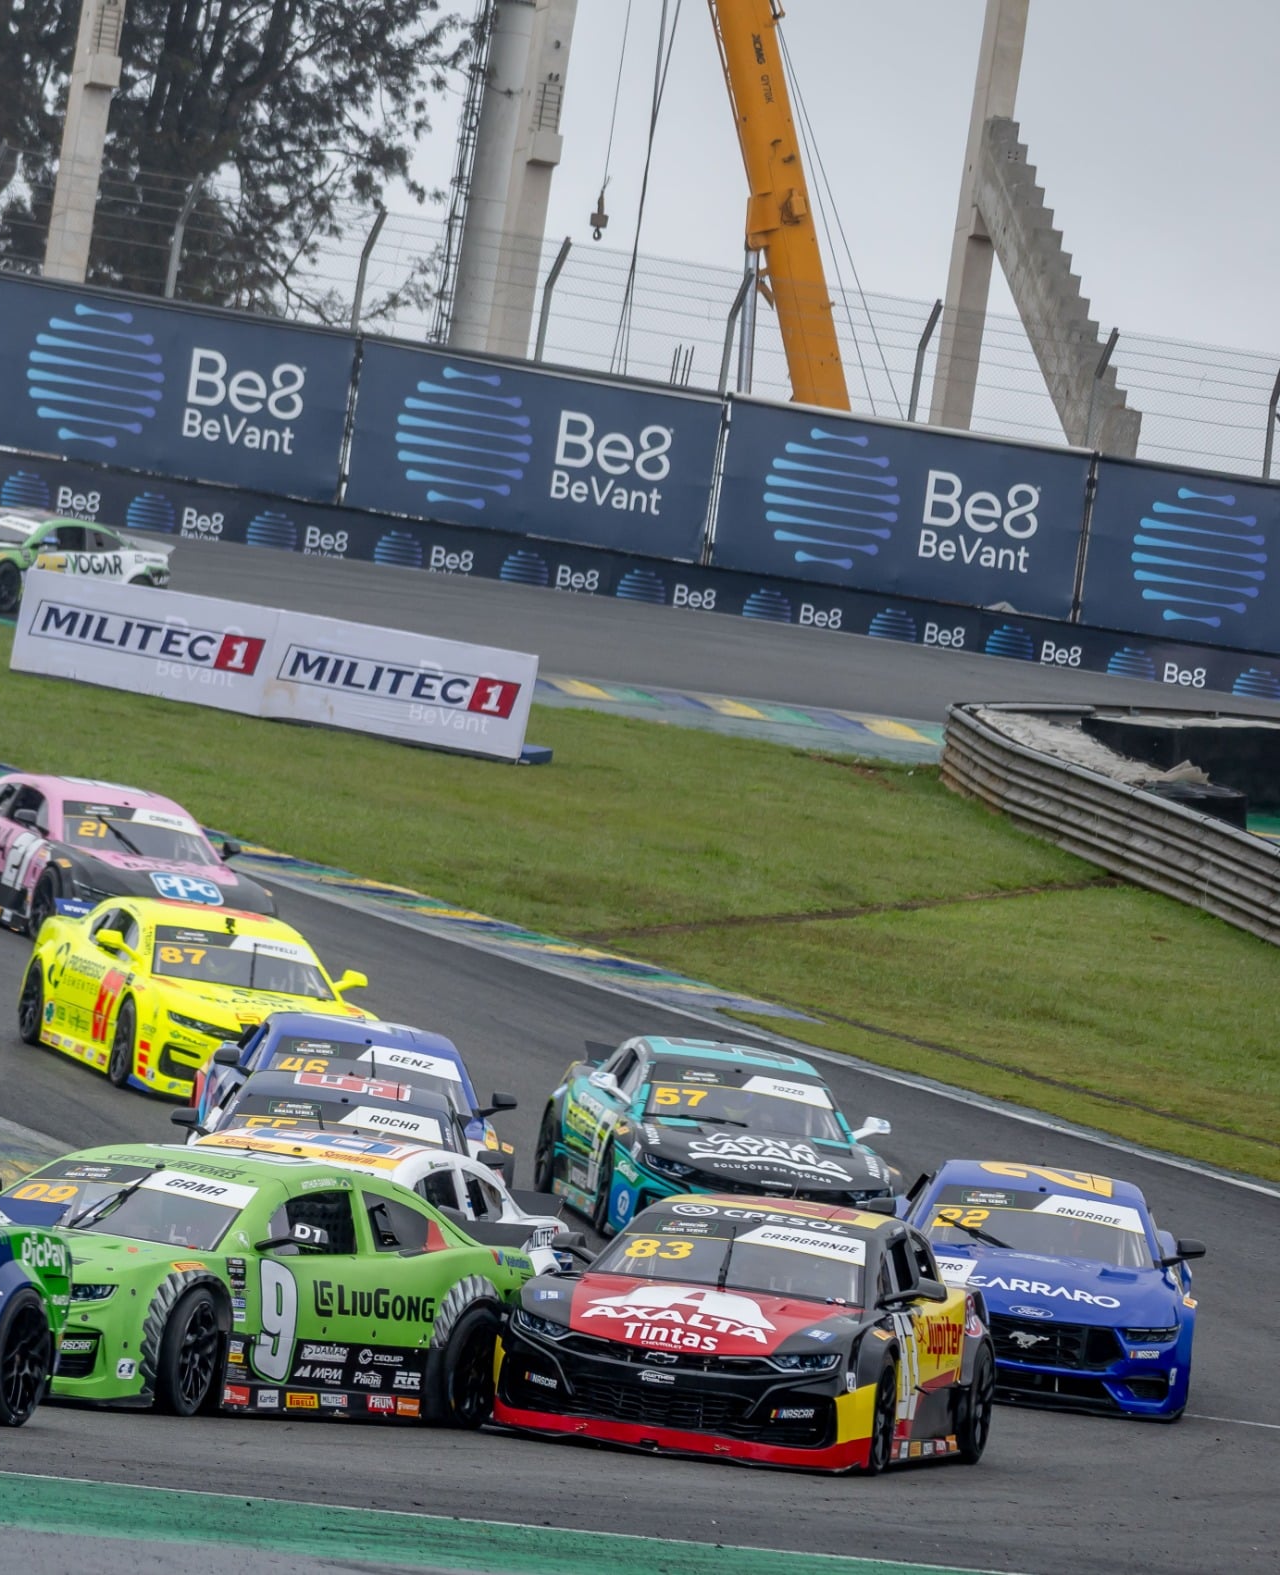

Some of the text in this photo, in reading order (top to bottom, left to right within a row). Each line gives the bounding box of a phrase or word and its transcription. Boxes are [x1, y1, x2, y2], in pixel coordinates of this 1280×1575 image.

[186, 347, 305, 421] Be8
[181, 408, 295, 455] BeVant
[554, 409, 672, 481] Be8
[57, 486, 101, 514] Be8
[549, 470, 662, 516] BeVant
[922, 469, 1040, 539] Be8
[182, 508, 224, 535] Be8
[305, 526, 348, 554] Be8
[918, 529, 1029, 573] BeVant
[68, 554, 123, 576] VOGAR
[430, 545, 474, 572] Be8
[556, 565, 599, 592] Be8
[673, 584, 716, 610] Be8
[799, 604, 842, 630] Be8
[41, 606, 250, 669] MILITEC 1
[923, 623, 965, 648] Be8
[1040, 640, 1082, 667] Be8
[288, 651, 504, 713] MILITEC 1
[1163, 662, 1206, 688] Be8
[78, 821, 108, 838] 21
[160, 874, 217, 898] PPG
[159, 946, 206, 964] 87
[278, 1057, 330, 1073] 46
[389, 1054, 435, 1070] GENZ
[655, 1087, 708, 1107] 57
[772, 1085, 805, 1096] TOZZO
[368, 1114, 421, 1131] ROCHA
[707, 1132, 819, 1158] CANA
[688, 1141, 849, 1174] CAYANA
[713, 1161, 832, 1184] SOLUÇÕES EM AÇÚCAR
[13, 1184, 79, 1202] 09
[165, 1178, 229, 1197] GAMA
[931, 1208, 990, 1228] 22
[1056, 1207, 1121, 1225] ANDRADE
[294, 1224, 323, 1243] D1
[761, 1232, 860, 1254] CASAGRANDE
[22, 1237, 66, 1275] PicPay
[625, 1239, 694, 1260] 83
[967, 1276, 1121, 1309] CARRARO
[254, 1258, 298, 1381] 9
[581, 1306, 768, 1344] AXALTA
[61, 1341, 90, 1350] ASCAR
[623, 1322, 718, 1351] Tintas
[641, 1340, 682, 1350] CHEVROLET
[373, 1353, 404, 1363] CEQUIP
[1135, 1350, 1160, 1360] NASCAR
[312, 1367, 343, 1380] MPM
[533, 1373, 558, 1389] NASCAR
[289, 1394, 315, 1407] PIRELLI
[782, 1408, 815, 1419] NASCAR
